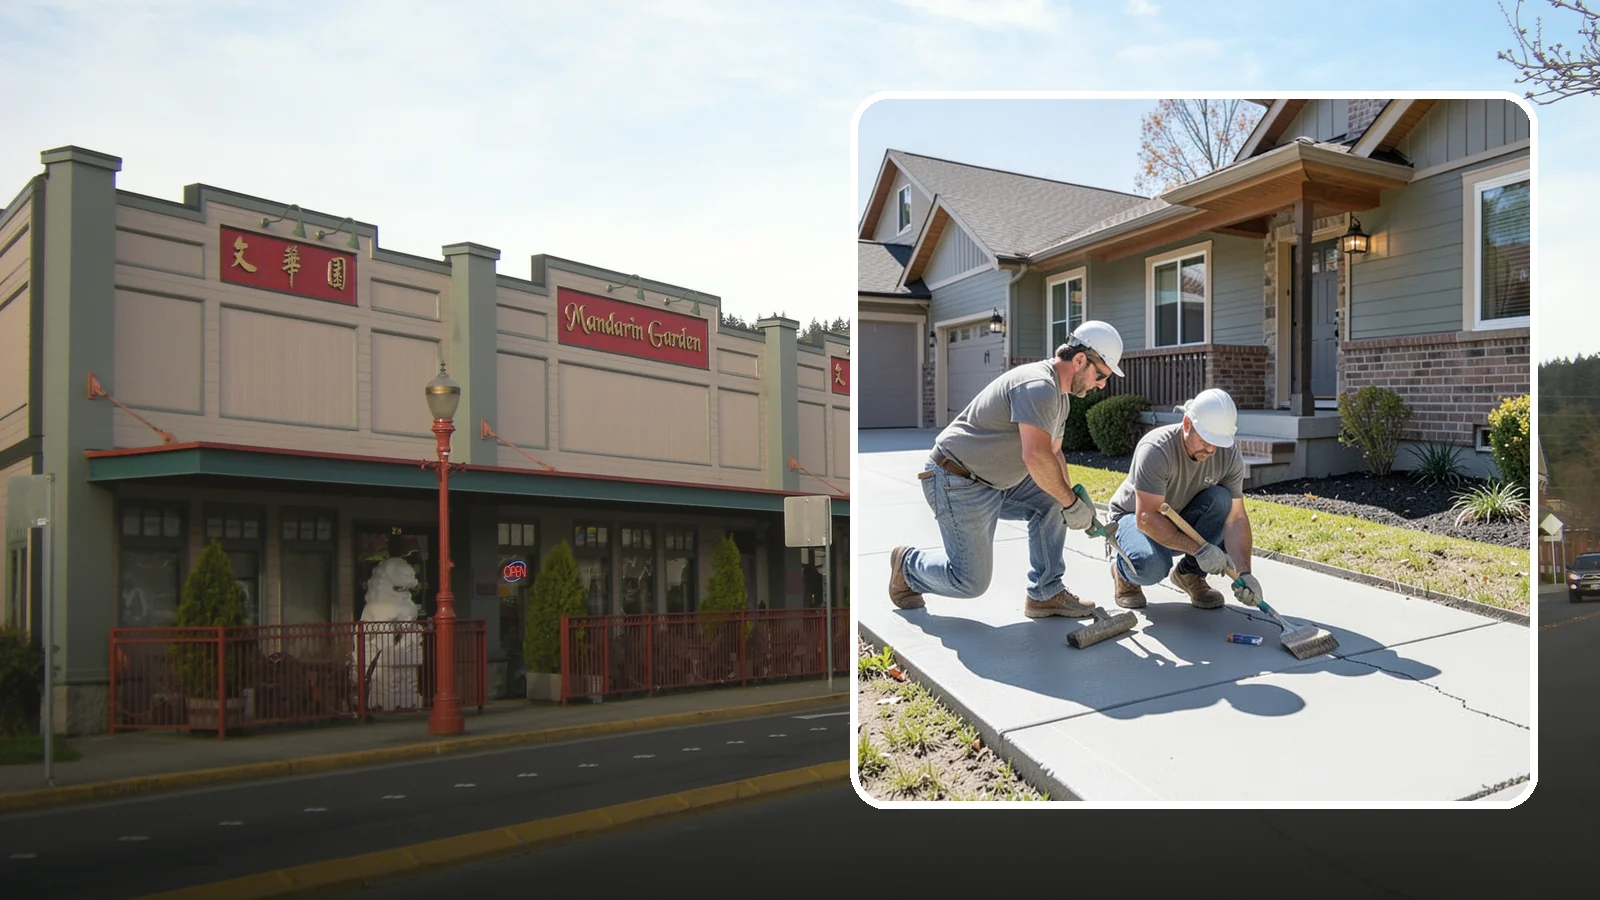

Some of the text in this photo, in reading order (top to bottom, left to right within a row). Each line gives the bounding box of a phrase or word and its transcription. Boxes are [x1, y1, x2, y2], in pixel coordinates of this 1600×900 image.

[230, 235, 347, 290] 文華園
[564, 302, 702, 352] Mandarin Garden
[503, 565, 527, 578] OPEN
